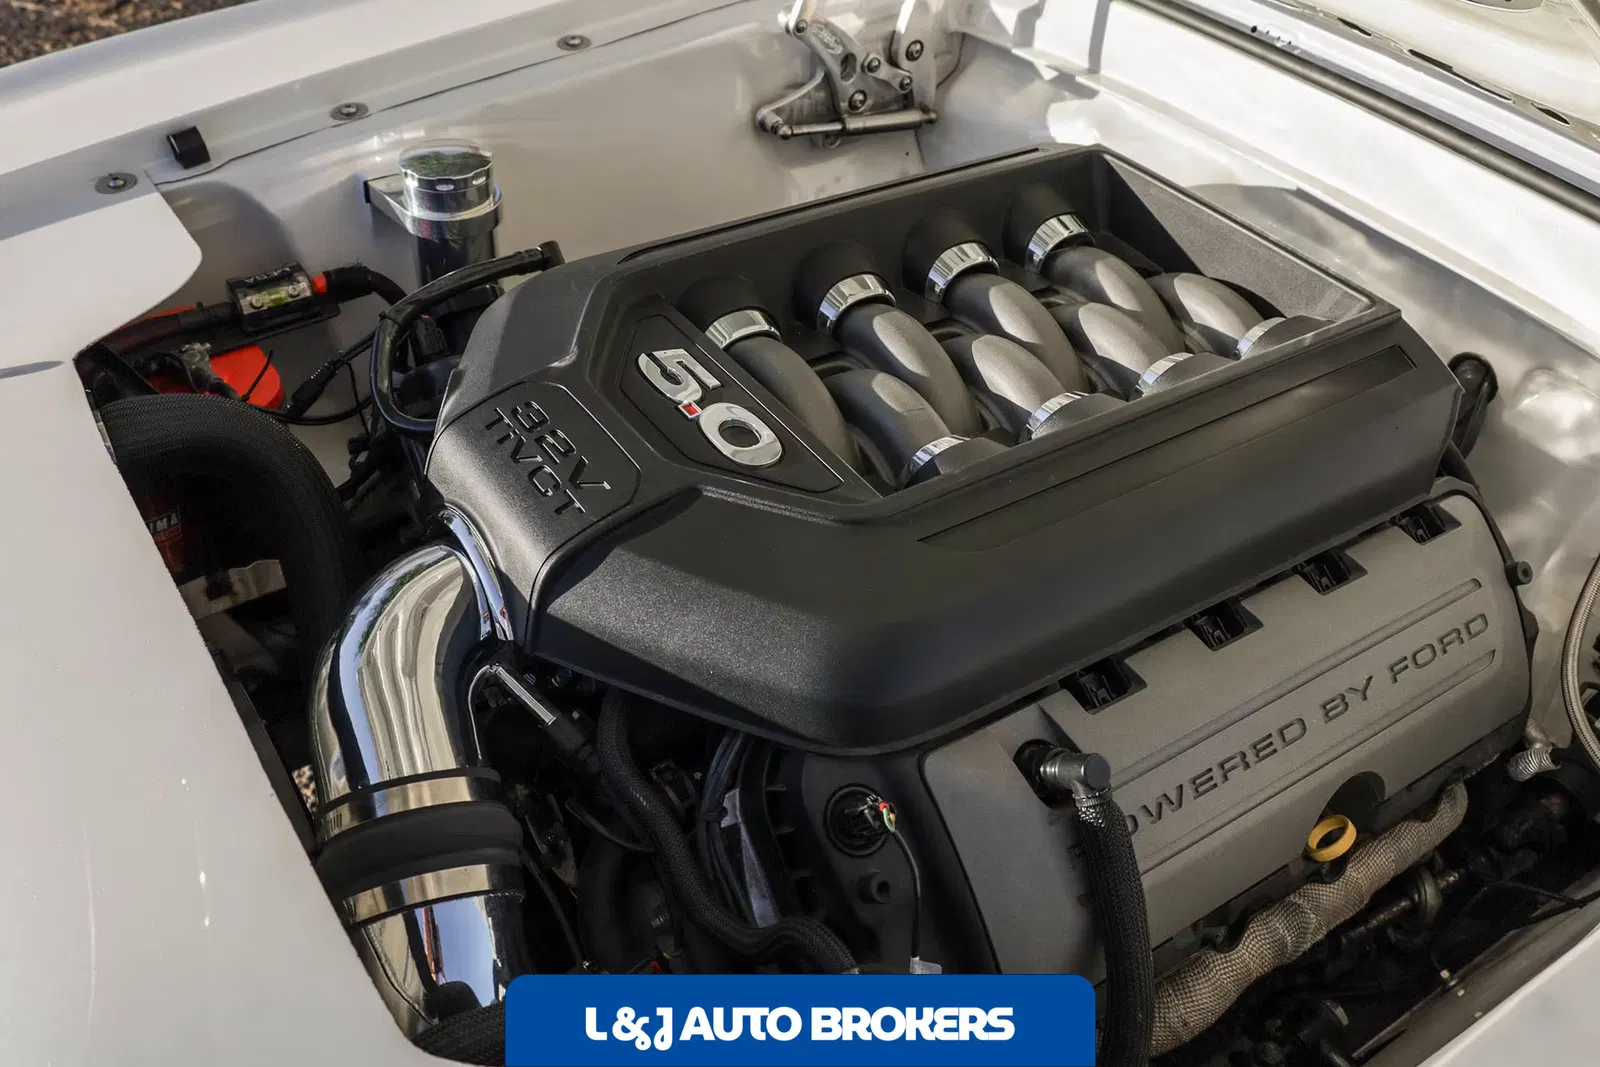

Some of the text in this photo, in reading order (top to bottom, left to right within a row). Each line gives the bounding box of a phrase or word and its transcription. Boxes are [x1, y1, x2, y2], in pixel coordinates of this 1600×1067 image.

[511, 400, 612, 489] 32V
[636, 348, 784, 467] 5.0
[1319, 675, 1373, 724] BY
[1387, 613, 1489, 685] FORD
